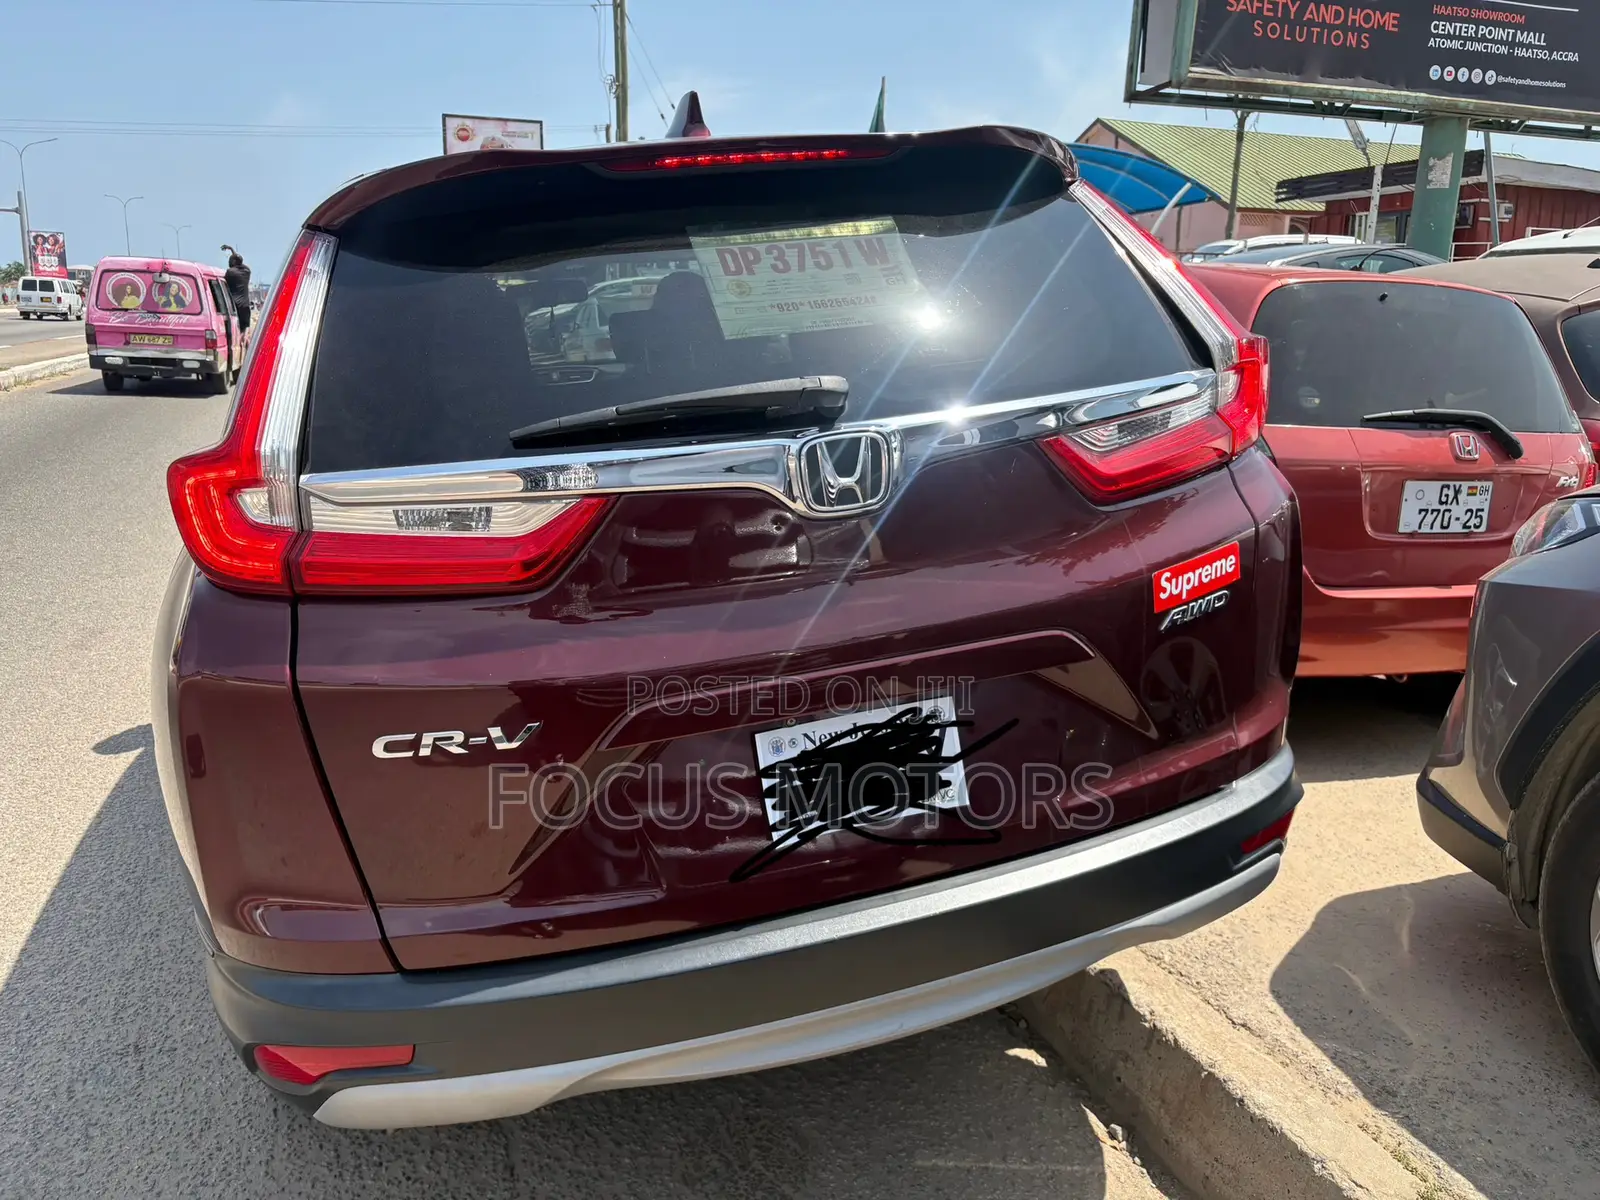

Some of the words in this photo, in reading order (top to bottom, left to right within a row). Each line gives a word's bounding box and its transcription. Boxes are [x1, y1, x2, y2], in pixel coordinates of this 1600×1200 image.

[1226, 0, 1300, 20] SAFETY
[1303, 2, 1344, 25] AND
[1348, 7, 1400, 32] HOME
[1432, 4, 1469, 17] HAATSO
[1470, 8, 1526, 24] SHOWROOM
[1253, 20, 1370, 49] SOLUTIONS
[1430, 20, 1476, 37] CENTER
[1478, 25, 1515, 42] POINT
[1516, 31, 1547, 46] MALL
[1427, 38, 1464, 50] ATOMIC
[1464, 41, 1509, 55] JUNCTION
[1514, 47, 1550, 61] HAATSO,
[1551, 51, 1579, 62] ACCRA
[1497, 75, 1566, 89] @safetyandhomesolutions
[715, 246, 762, 276] DP
[764, 239, 853, 275] 3751
[853, 236, 891, 267] W
[1438, 484, 1462, 506] GX
[1478, 485, 1490, 497] GH
[1418, 508, 1484, 530] 770-25
[1159, 554, 1236, 600] Supreme
[1160, 590, 1229, 631] AWD
[371, 721, 542, 759] CR-V
